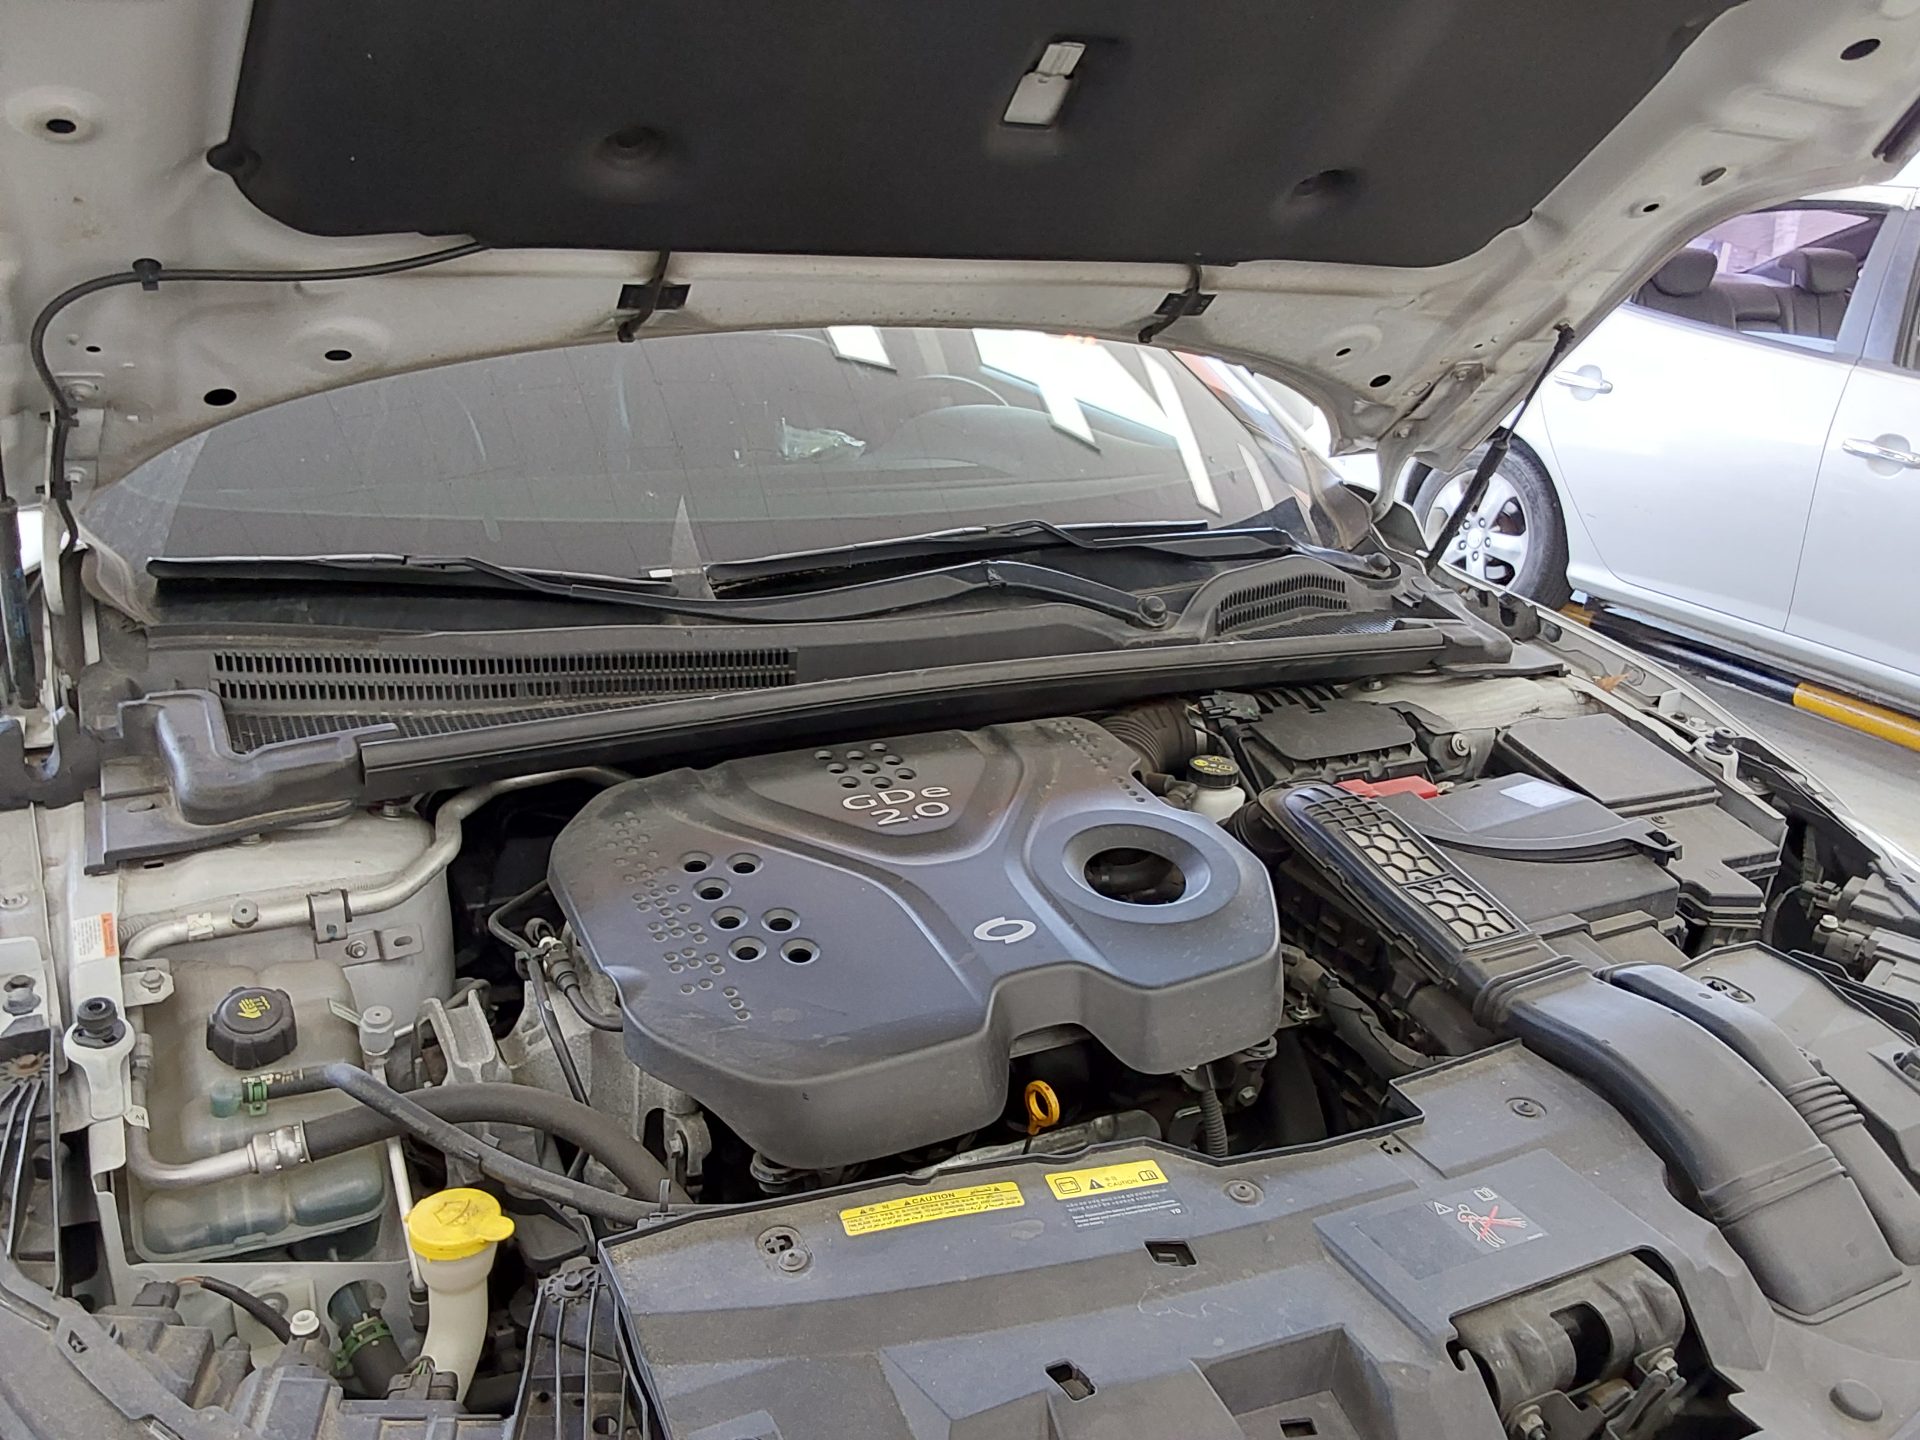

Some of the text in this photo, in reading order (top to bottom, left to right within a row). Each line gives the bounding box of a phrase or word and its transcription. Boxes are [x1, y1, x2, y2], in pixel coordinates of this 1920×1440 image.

[870, 801, 950, 826] 2.0
[1107, 1178, 1138, 1188] CAUTION
[912, 1192, 955, 1205] CAUTION
